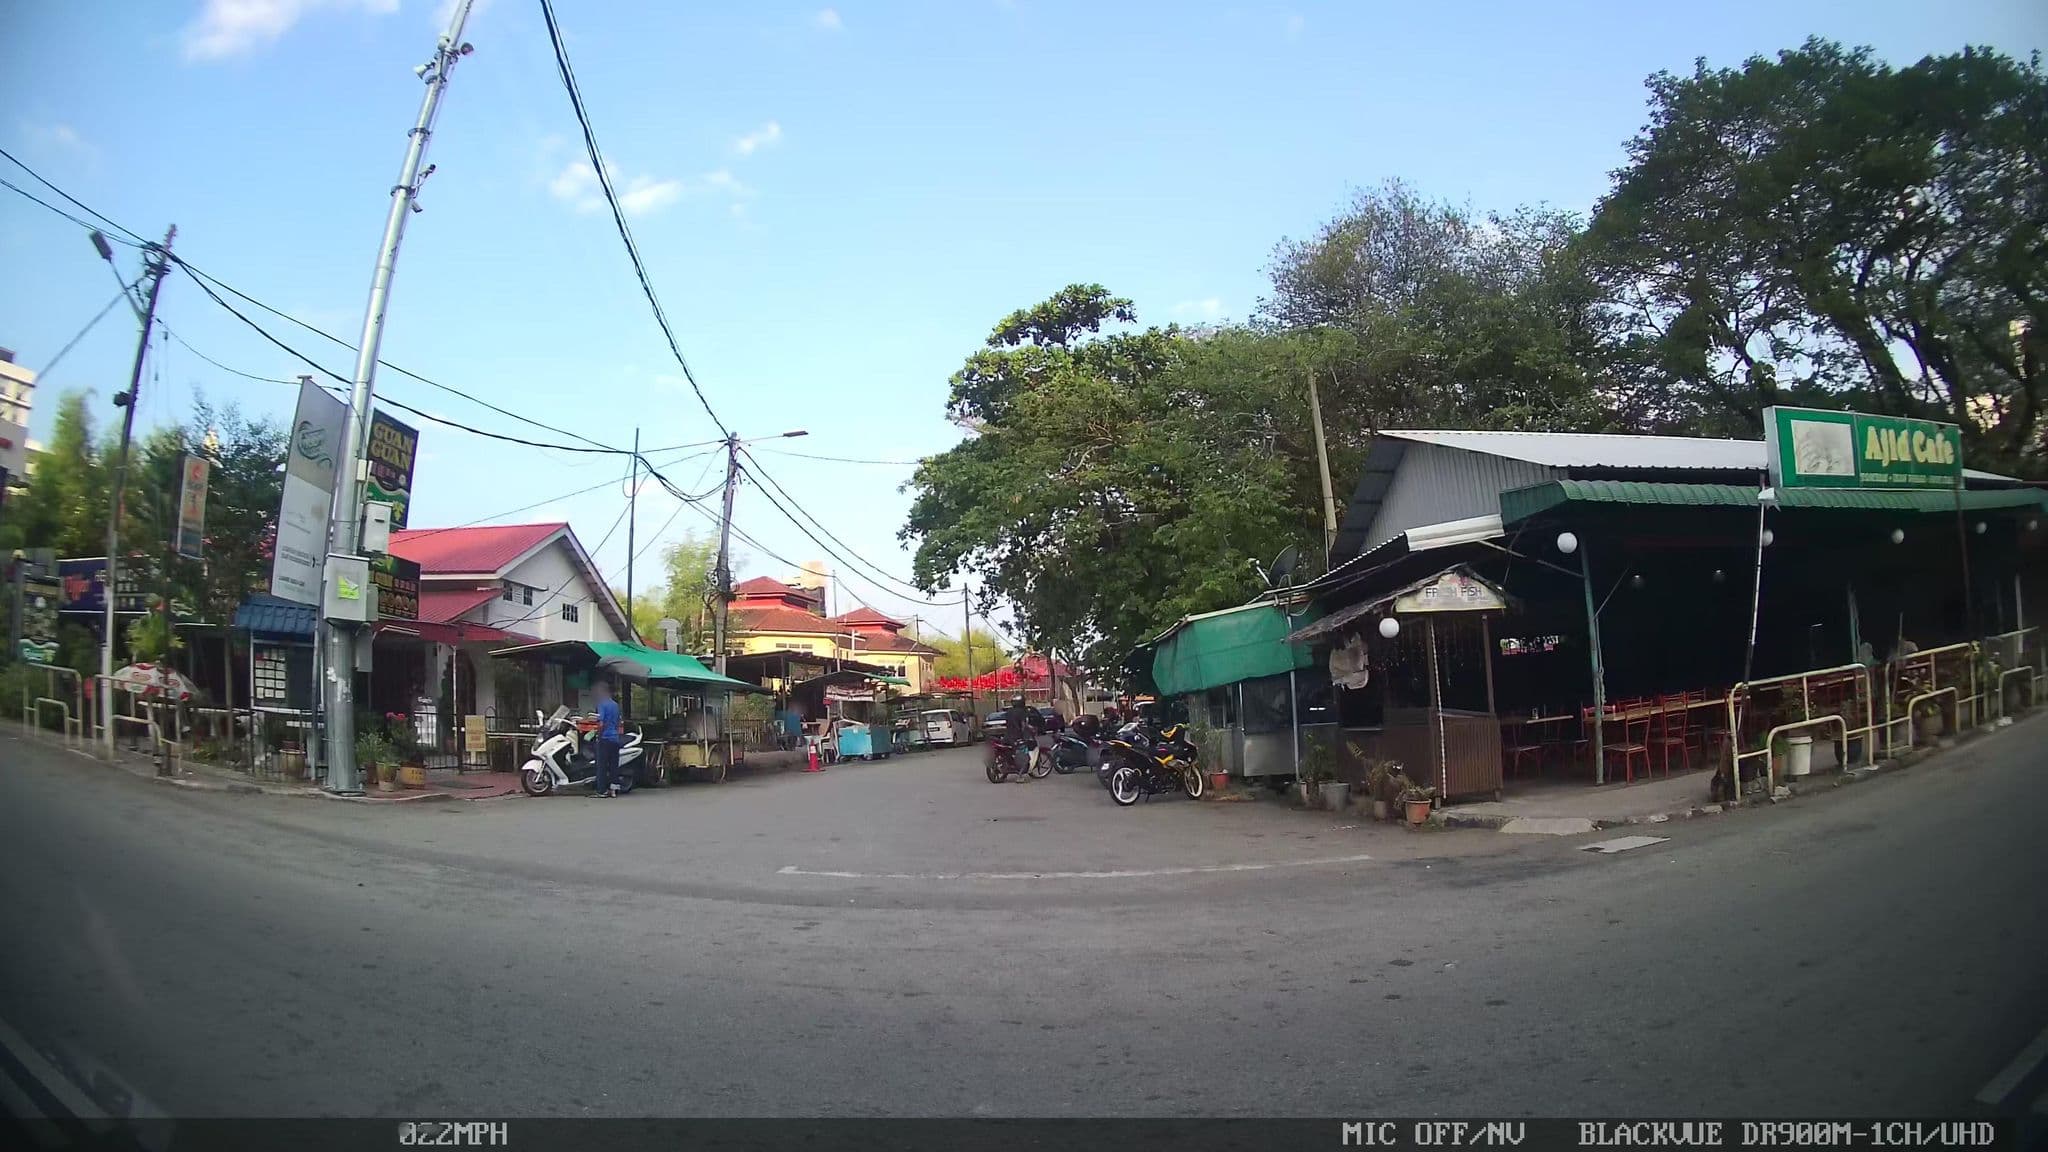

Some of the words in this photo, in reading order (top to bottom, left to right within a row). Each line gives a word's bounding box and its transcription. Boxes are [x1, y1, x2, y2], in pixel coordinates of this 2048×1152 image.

[371, 439, 411, 471] GUAN
[373, 424, 414, 455] GUAN
[1912, 430, 1955, 465] Cafe
